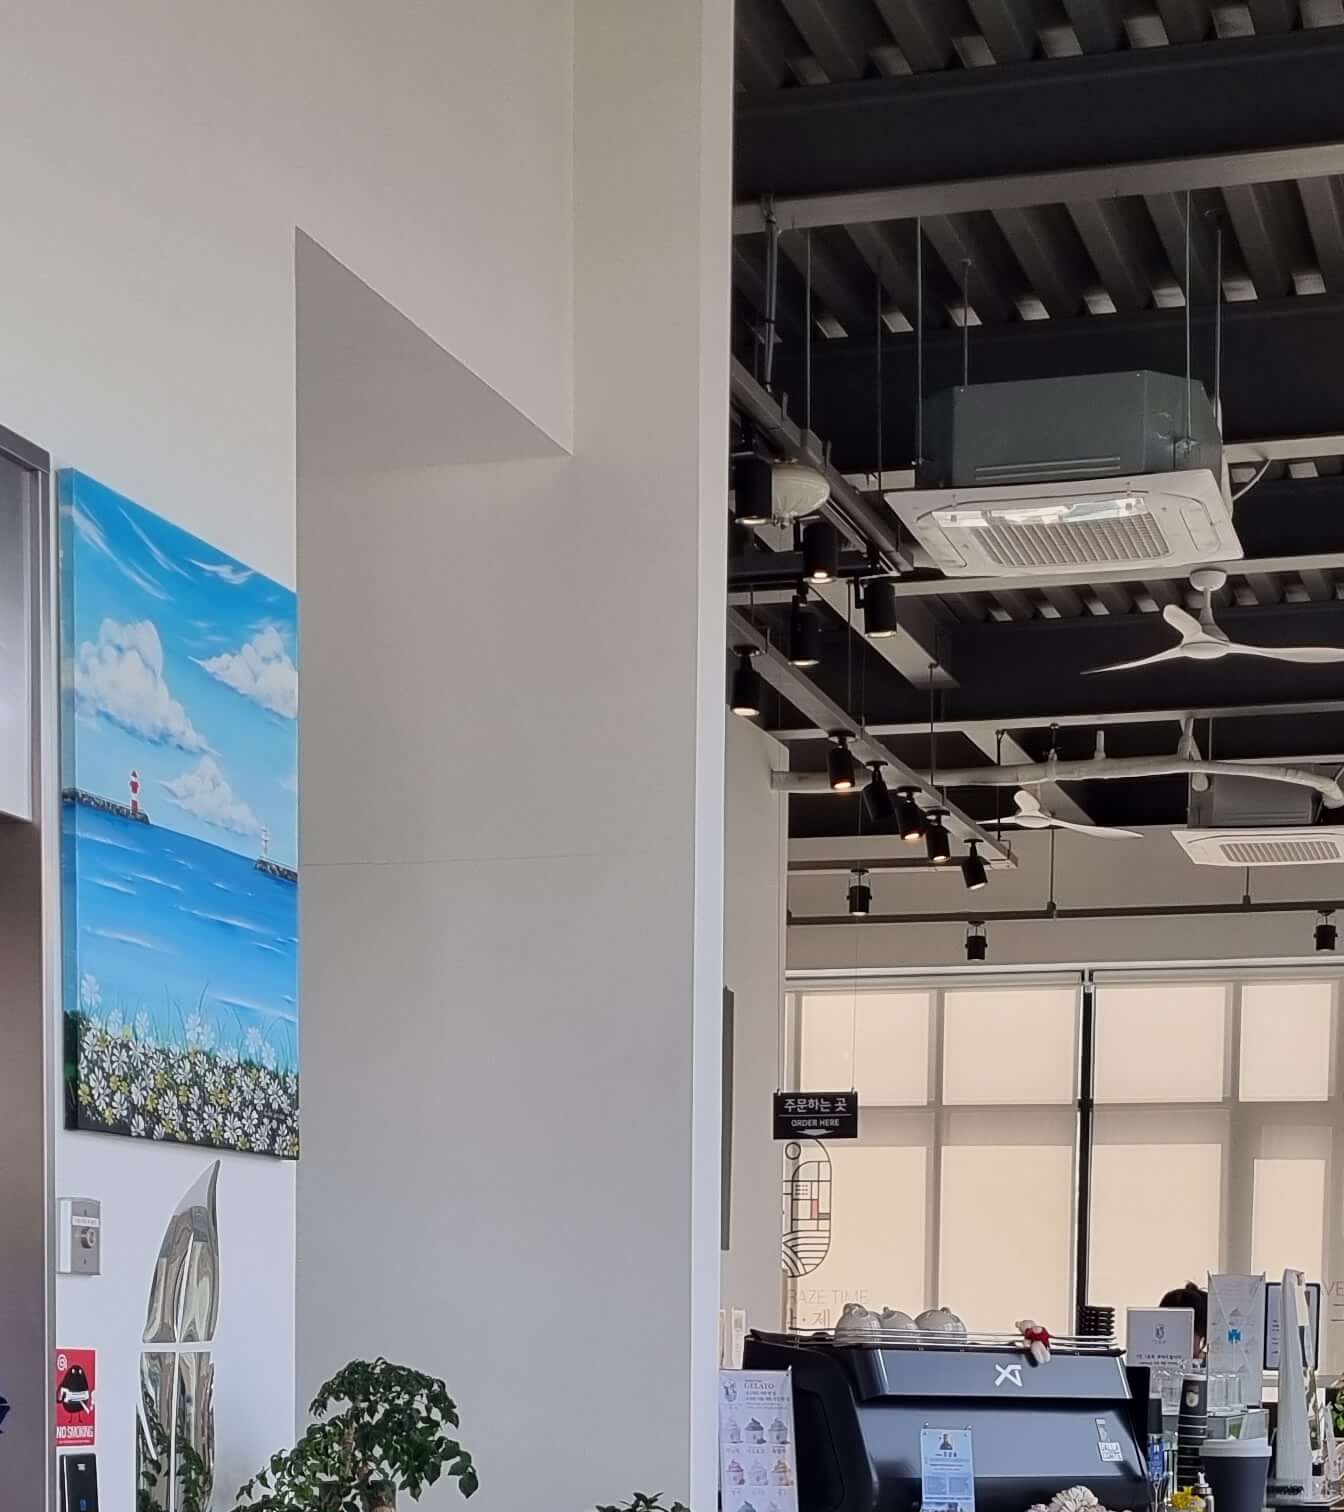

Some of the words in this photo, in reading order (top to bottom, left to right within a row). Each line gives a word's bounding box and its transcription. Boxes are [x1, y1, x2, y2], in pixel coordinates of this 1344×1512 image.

[784, 1098, 832, 1113] 주문하는
[834, 1097, 847, 1112] 곳
[791, 1119, 818, 1127] ORDER
[819, 1118, 840, 1127] HERE
[56, 1426, 66, 1438] NO
[67, 1426, 94, 1438] SMOKING
